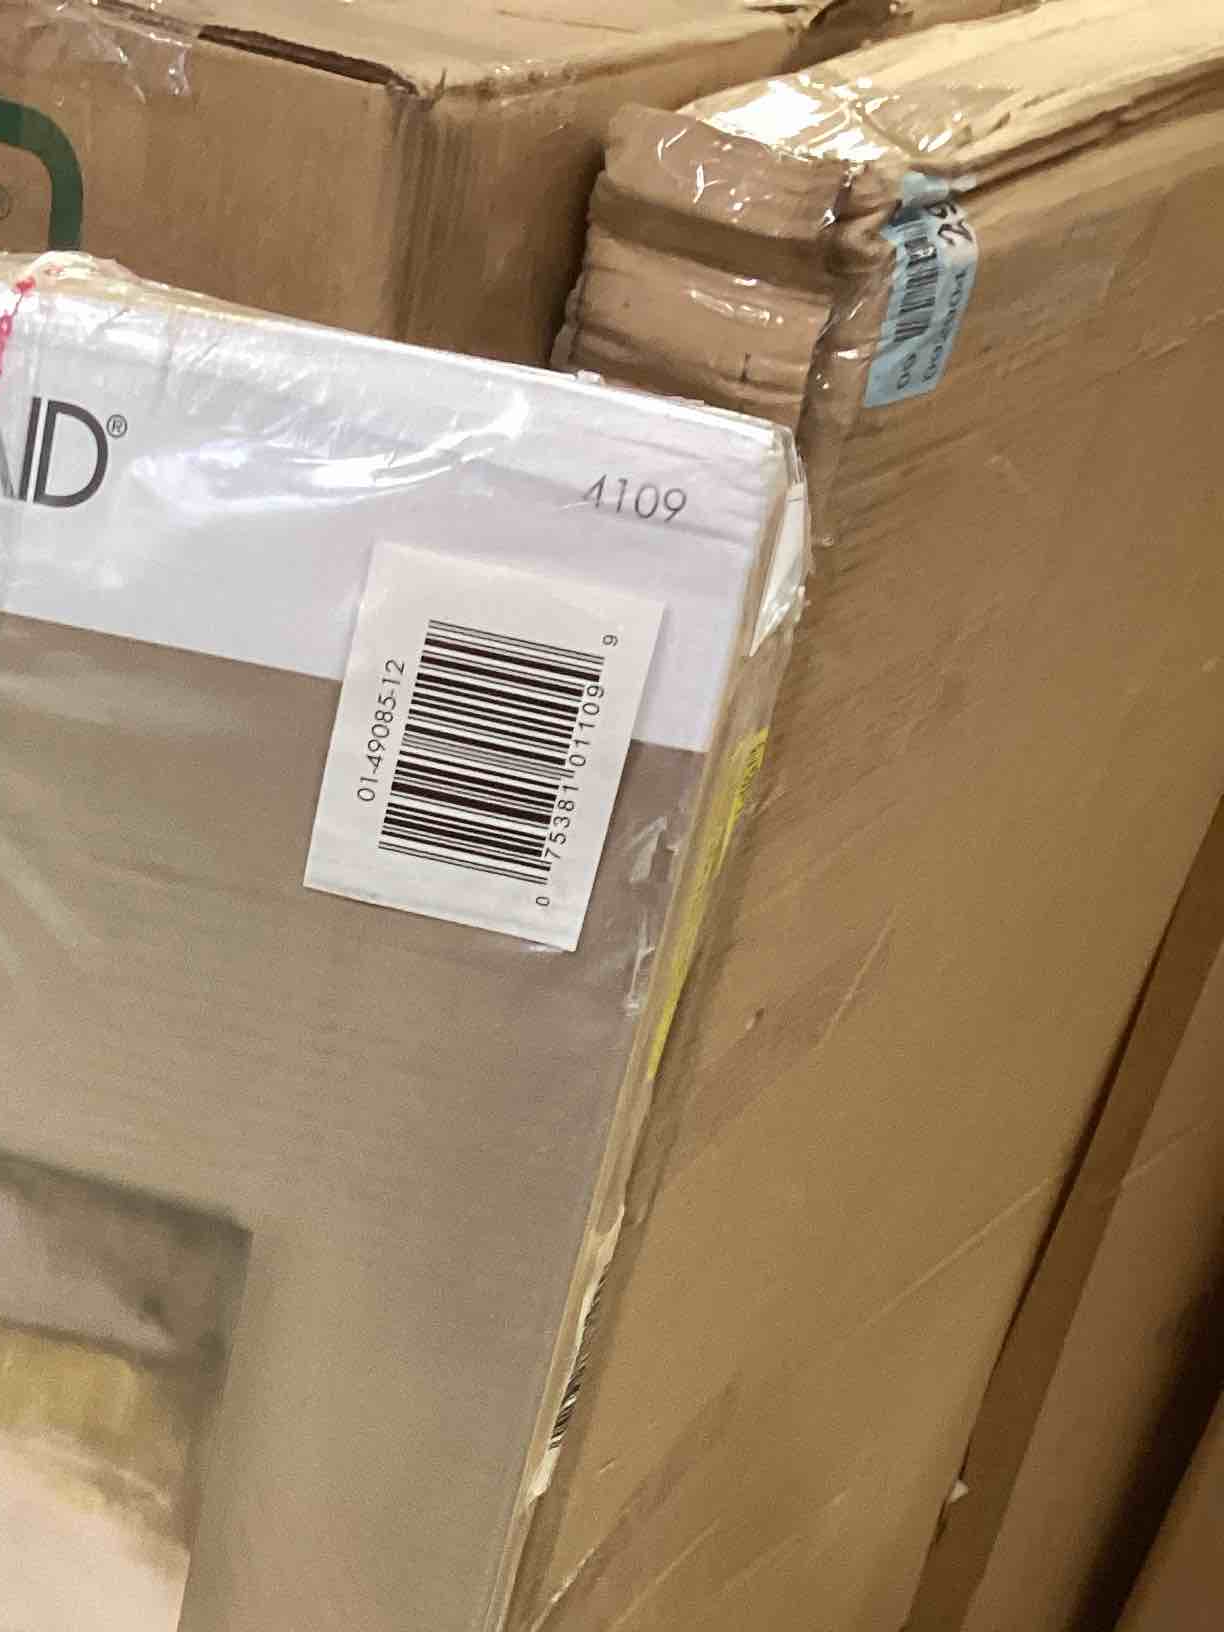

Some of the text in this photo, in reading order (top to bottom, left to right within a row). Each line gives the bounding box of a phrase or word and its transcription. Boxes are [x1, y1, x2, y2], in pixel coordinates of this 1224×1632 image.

[357, 659, 406, 802] 01-49085-12
[544, 784, 581, 861] 75381
[568, 685, 605, 768] 01109
